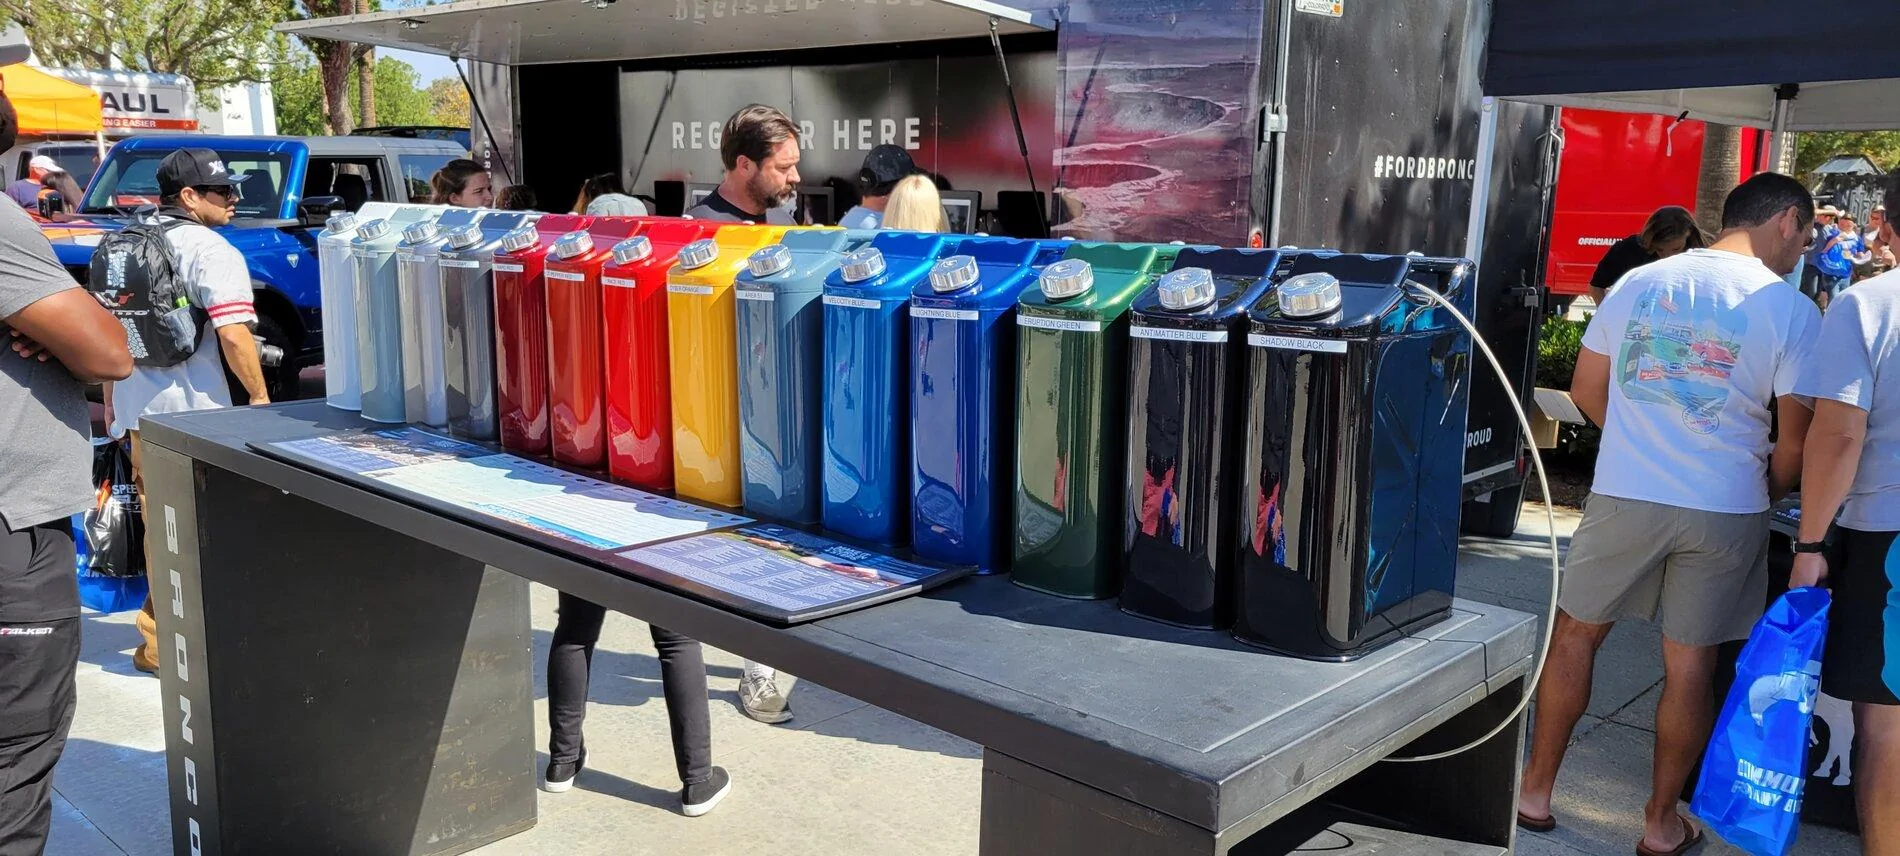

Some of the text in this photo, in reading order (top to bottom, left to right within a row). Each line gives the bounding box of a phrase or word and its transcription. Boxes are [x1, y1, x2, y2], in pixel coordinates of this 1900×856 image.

[122, 118, 156, 127] EASIER
[672, 117, 920, 150] REGR HERE
[828, 297, 851, 306] VELOCITY
[915, 309, 961, 319] LIGHTNING BLUE
[1024, 317, 1081, 329] ERUPTION GREEN
[1140, 329, 1207, 340] ANTIMATTER BLUE
[1260, 336, 1325, 349] SHADOW BLACK
[164, 504, 202, 856] BRONCO
